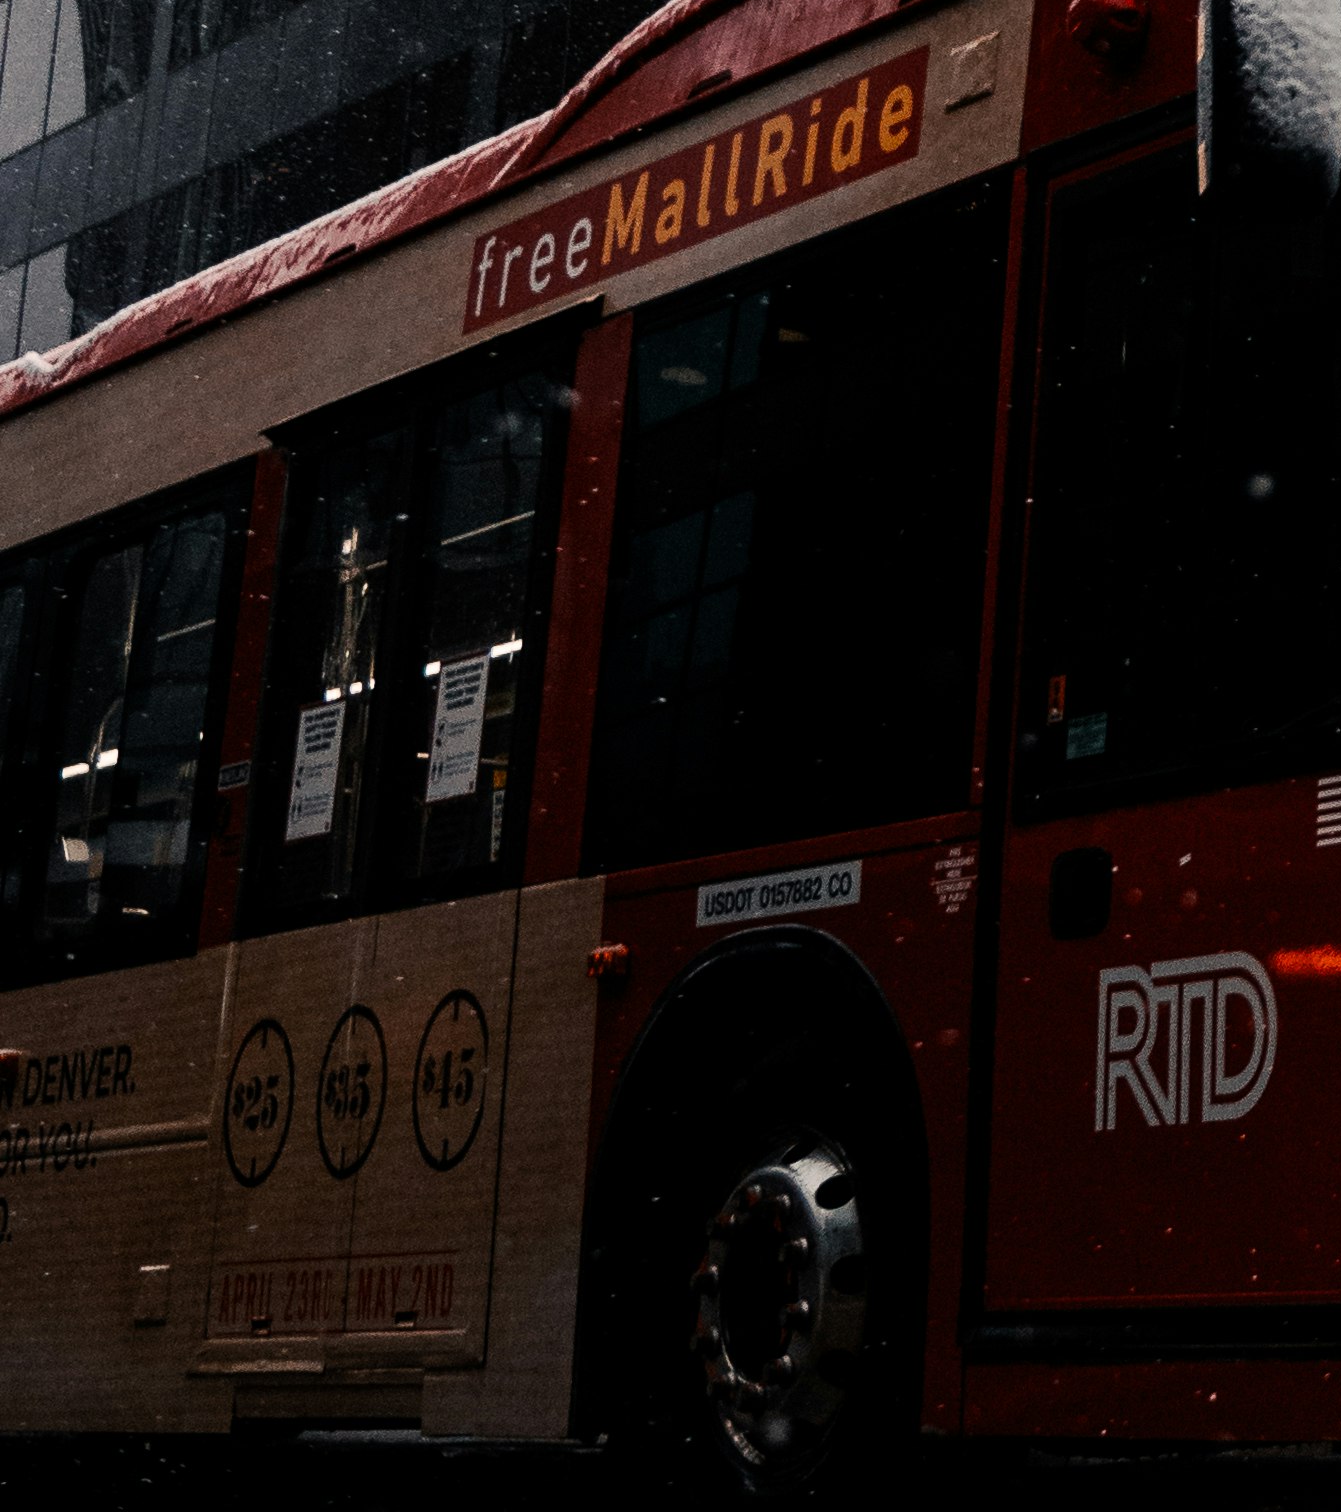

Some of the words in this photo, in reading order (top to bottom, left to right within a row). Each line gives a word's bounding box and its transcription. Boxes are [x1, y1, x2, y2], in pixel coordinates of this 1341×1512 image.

[704, 887, 755, 917] USDOT
[828, 872, 852, 897] CO
[1095, 950, 1278, 1132] RTD
[233, 1076, 279, 1130] $25
[325, 1062, 371, 1120] $35
[422, 1047, 475, 1109] $45
[219, 1272, 272, 1322] APRIL
[356, 1266, 402, 1321] MAY
[412, 1264, 453, 1318] 2ND
